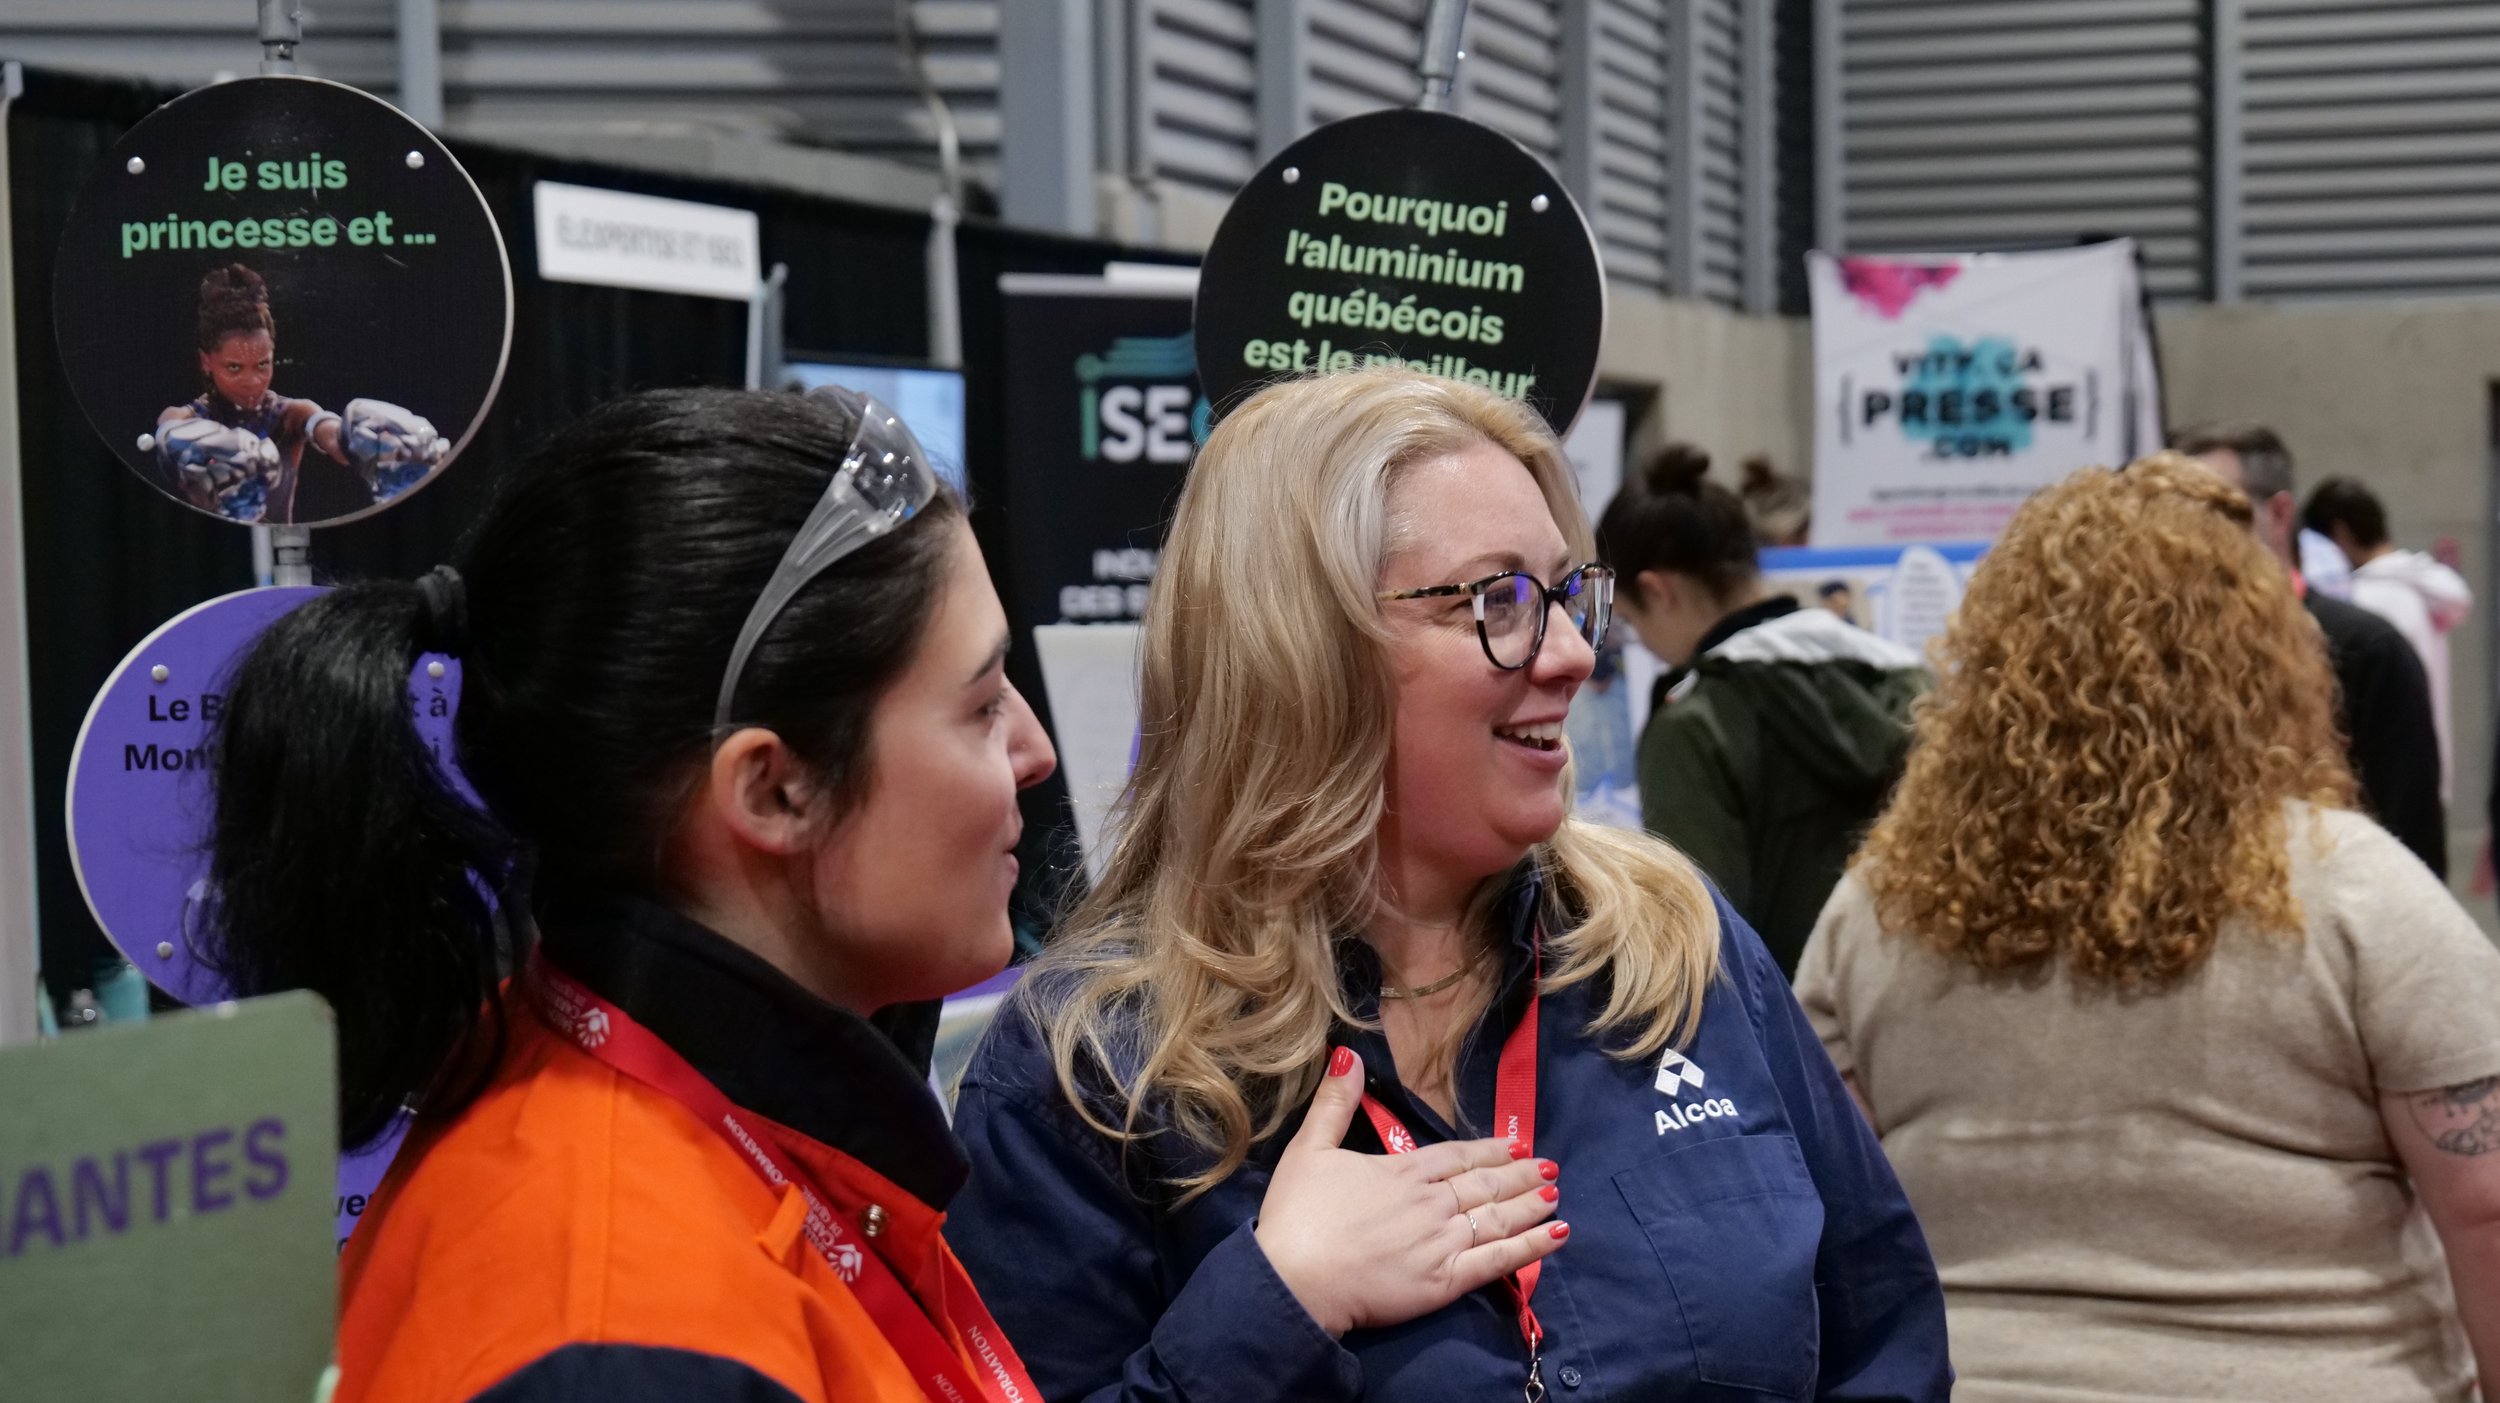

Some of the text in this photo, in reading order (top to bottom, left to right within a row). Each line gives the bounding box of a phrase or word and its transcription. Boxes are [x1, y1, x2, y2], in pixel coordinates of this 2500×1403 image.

[204, 152, 348, 191] Je suis
[1318, 182, 1508, 237] Pourquoi
[121, 213, 337, 258] princesse
[347, 210, 393, 245] et
[1288, 288, 1504, 345] québécois
[1243, 338, 1310, 370] est
[1317, 340, 1355, 372] le
[1863, 386, 2075, 426] PRESSE
[149, 695, 190, 721] Le
[1654, 1098, 1739, 1136] Alcoa
[0, 1116, 289, 1257] ANTES
